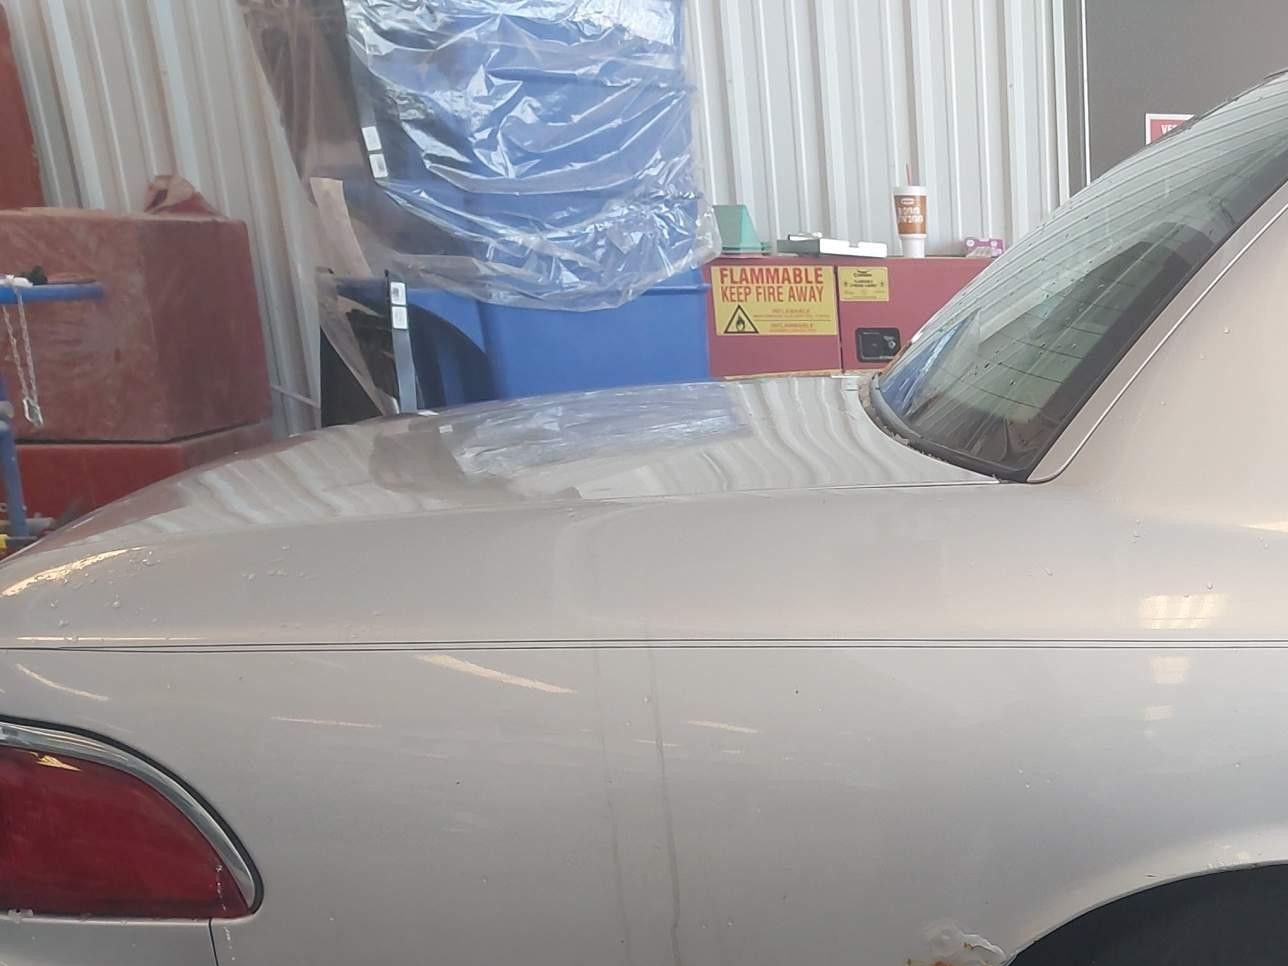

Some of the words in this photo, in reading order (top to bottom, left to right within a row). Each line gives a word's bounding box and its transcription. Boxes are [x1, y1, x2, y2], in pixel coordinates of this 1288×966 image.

[719, 267, 824, 285] FLAMMABLE
[721, 286, 752, 303] KEEP
[755, 286, 785, 303] FIRE
[788, 286, 825, 302] AWAY
